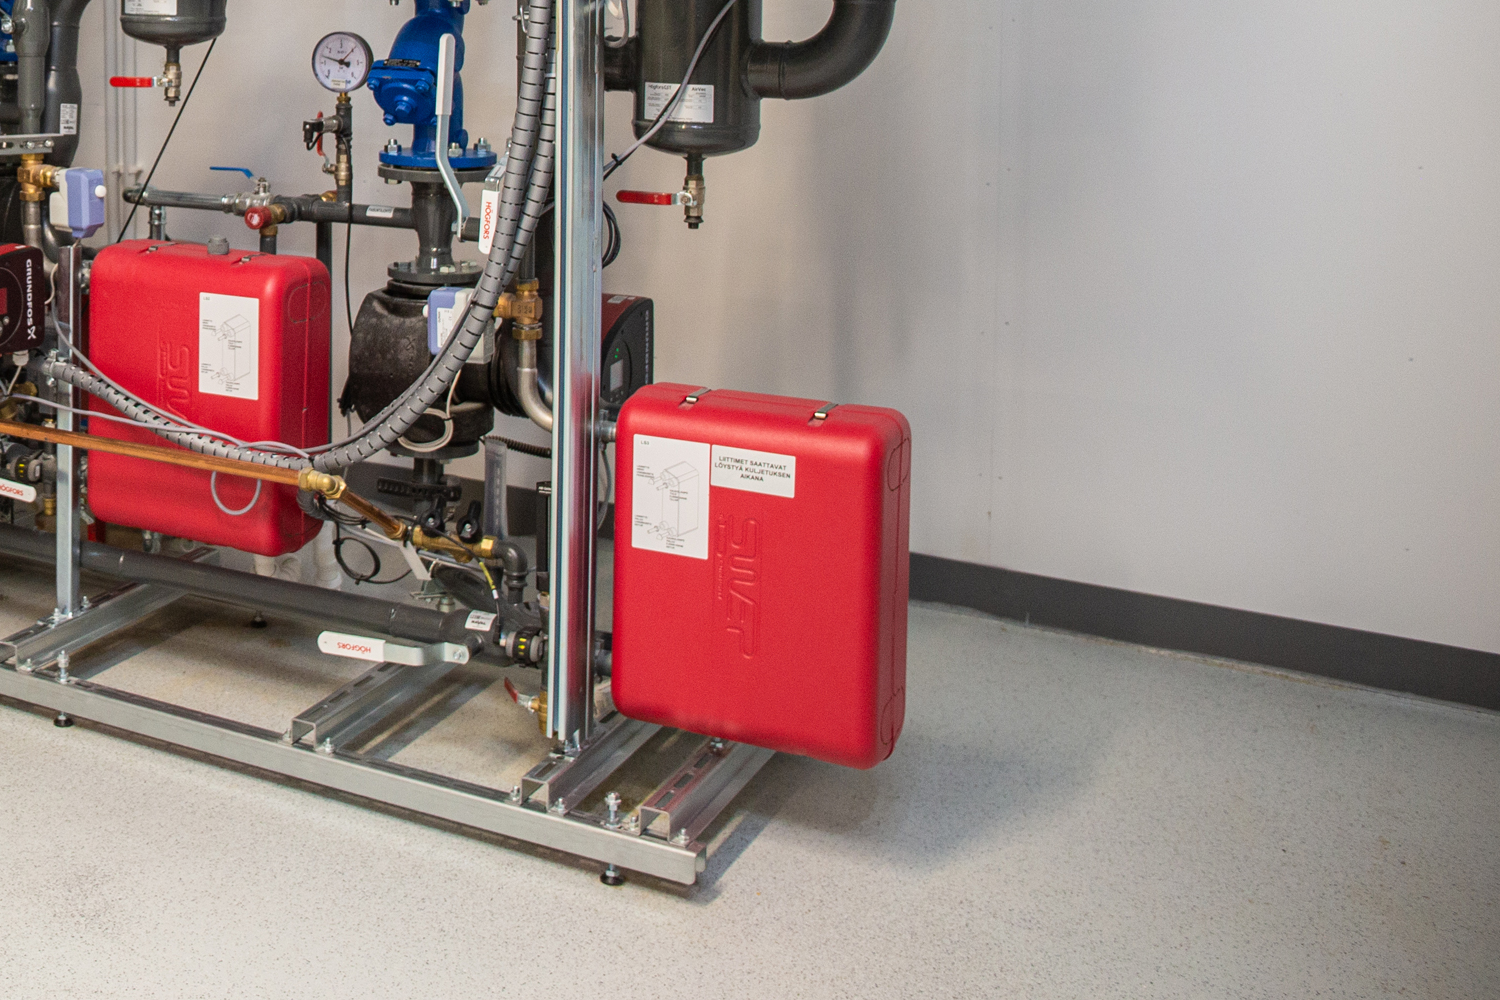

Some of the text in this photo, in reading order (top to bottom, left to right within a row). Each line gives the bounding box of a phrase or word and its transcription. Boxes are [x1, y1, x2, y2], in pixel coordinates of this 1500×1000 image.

[482, 201, 494, 240] HÖGFORS
[714, 462, 791, 479] LÖYSTYÄ KULJETUKSEN
[718, 455, 787, 471] LIITTIMET SAATTAVAT
[740, 473, 764, 482] AIKANA
[337, 641, 372, 655] HÖGFORS
